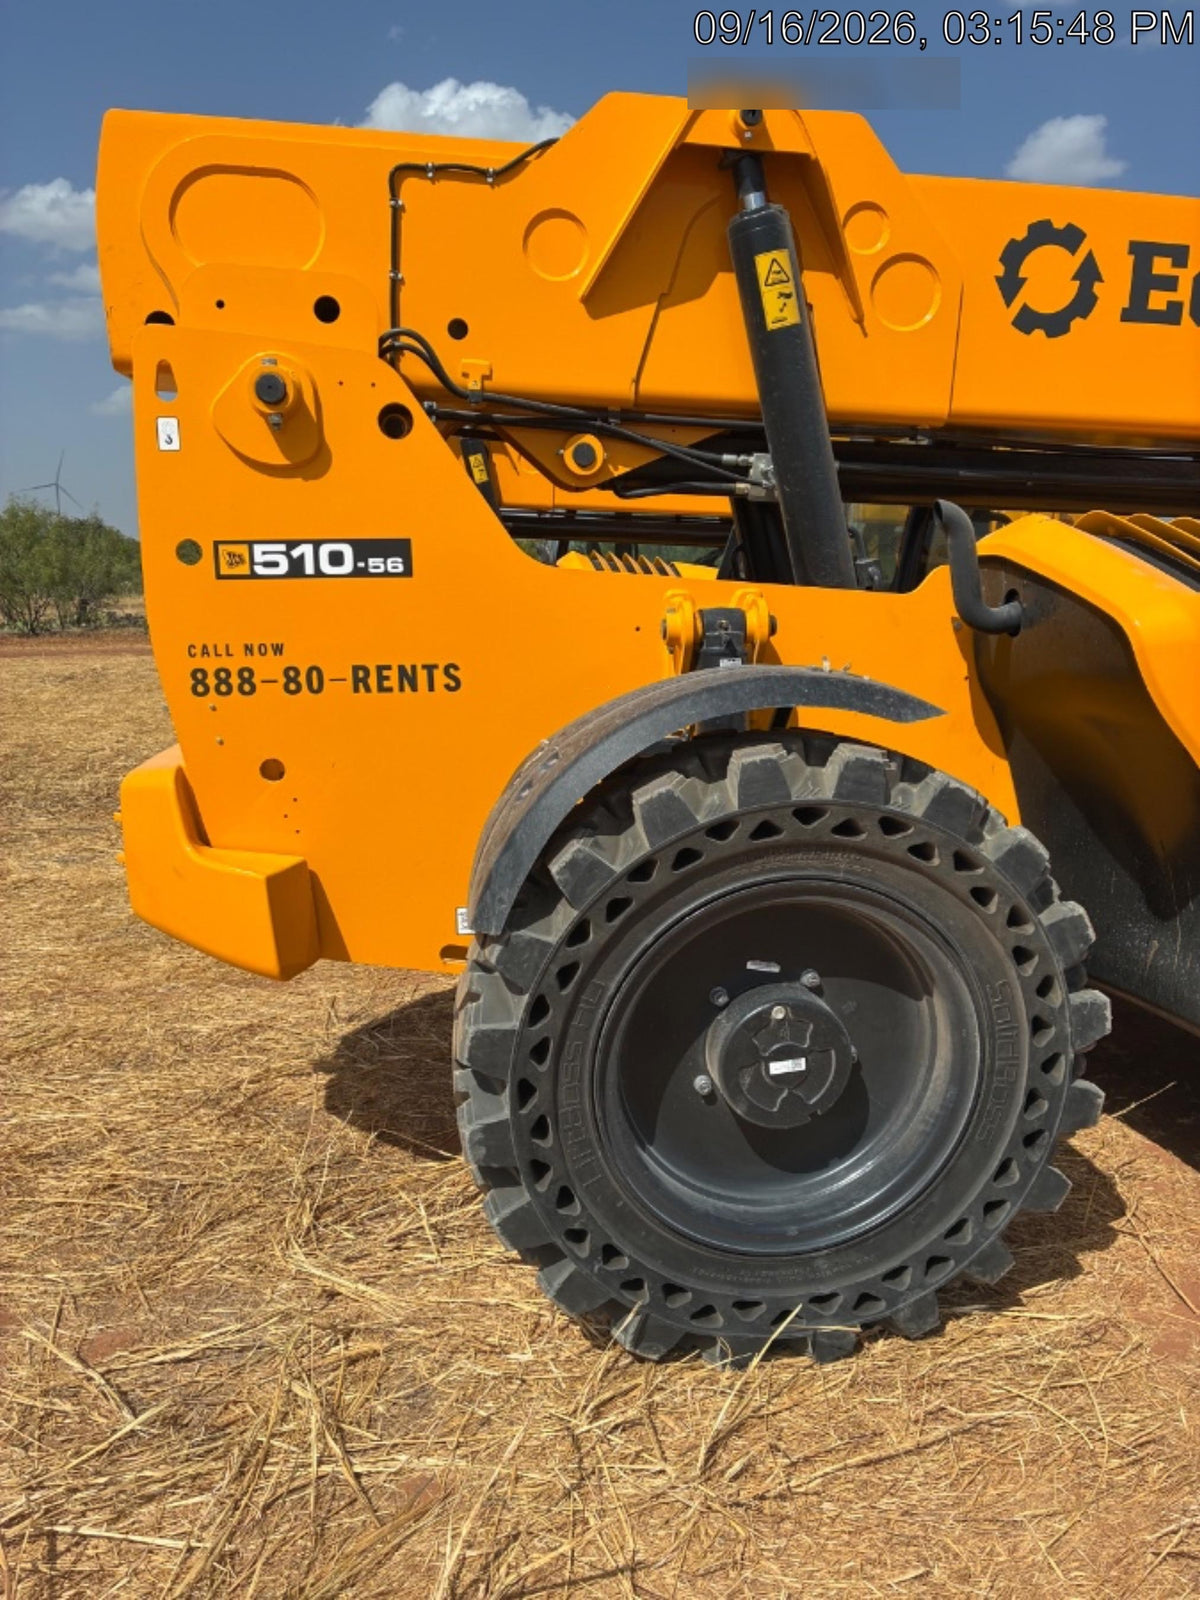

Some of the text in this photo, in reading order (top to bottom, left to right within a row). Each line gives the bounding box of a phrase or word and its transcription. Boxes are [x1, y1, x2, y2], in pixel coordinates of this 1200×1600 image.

[1120, 240, 1200, 329] E
[253, 543, 404, 575] 510-56
[187, 643, 285, 658] CALL NOW
[190, 663, 462, 697] 888-80-RENTS
